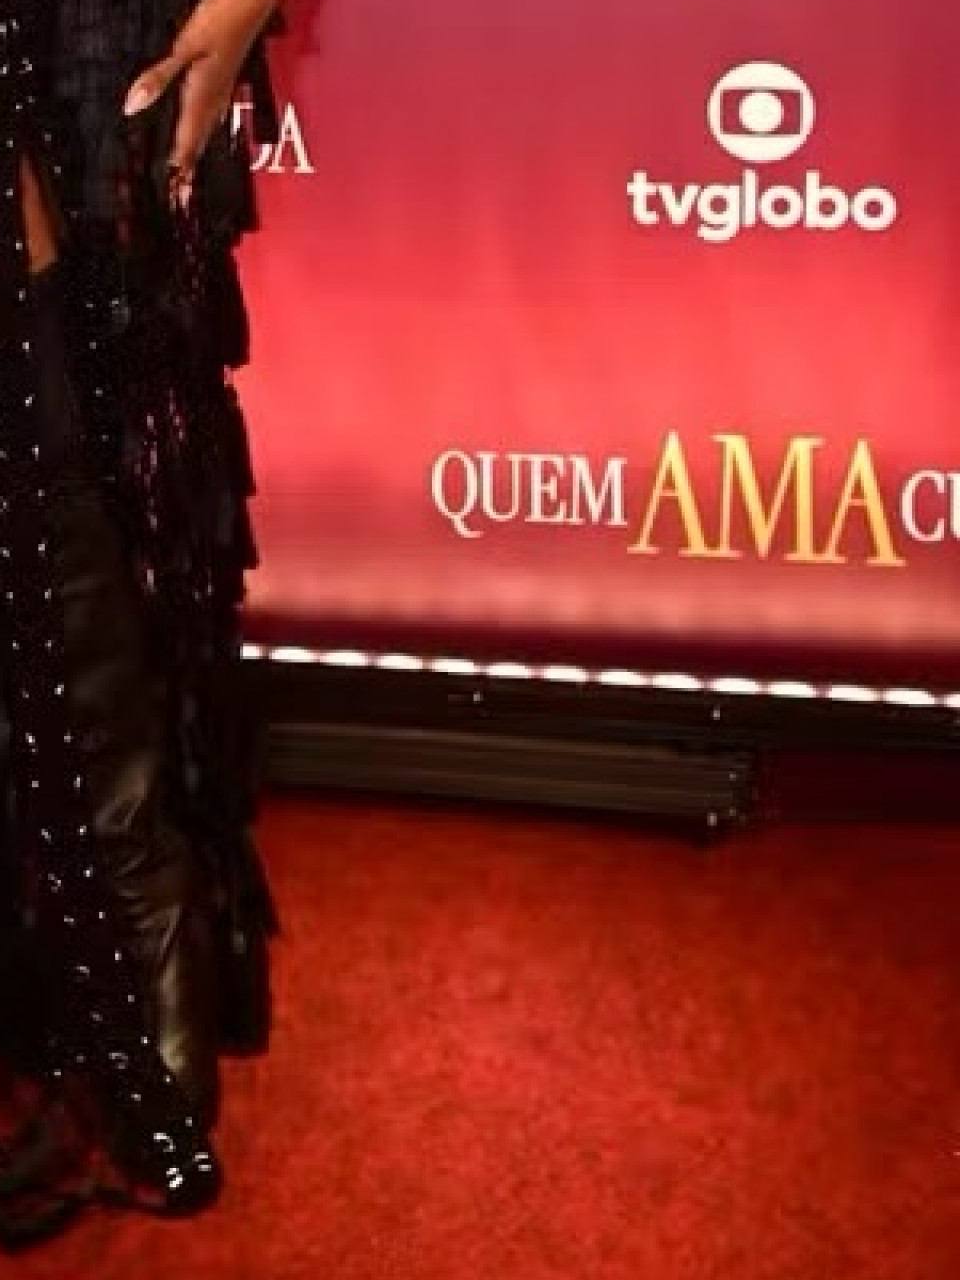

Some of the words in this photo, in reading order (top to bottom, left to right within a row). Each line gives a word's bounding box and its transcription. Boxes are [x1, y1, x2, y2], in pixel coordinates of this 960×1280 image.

[627, 169, 897, 242] tvglobo
[430, 450, 628, 538] QUEM
[628, 429, 908, 567] AMA
[900, 470, 960, 542] C
